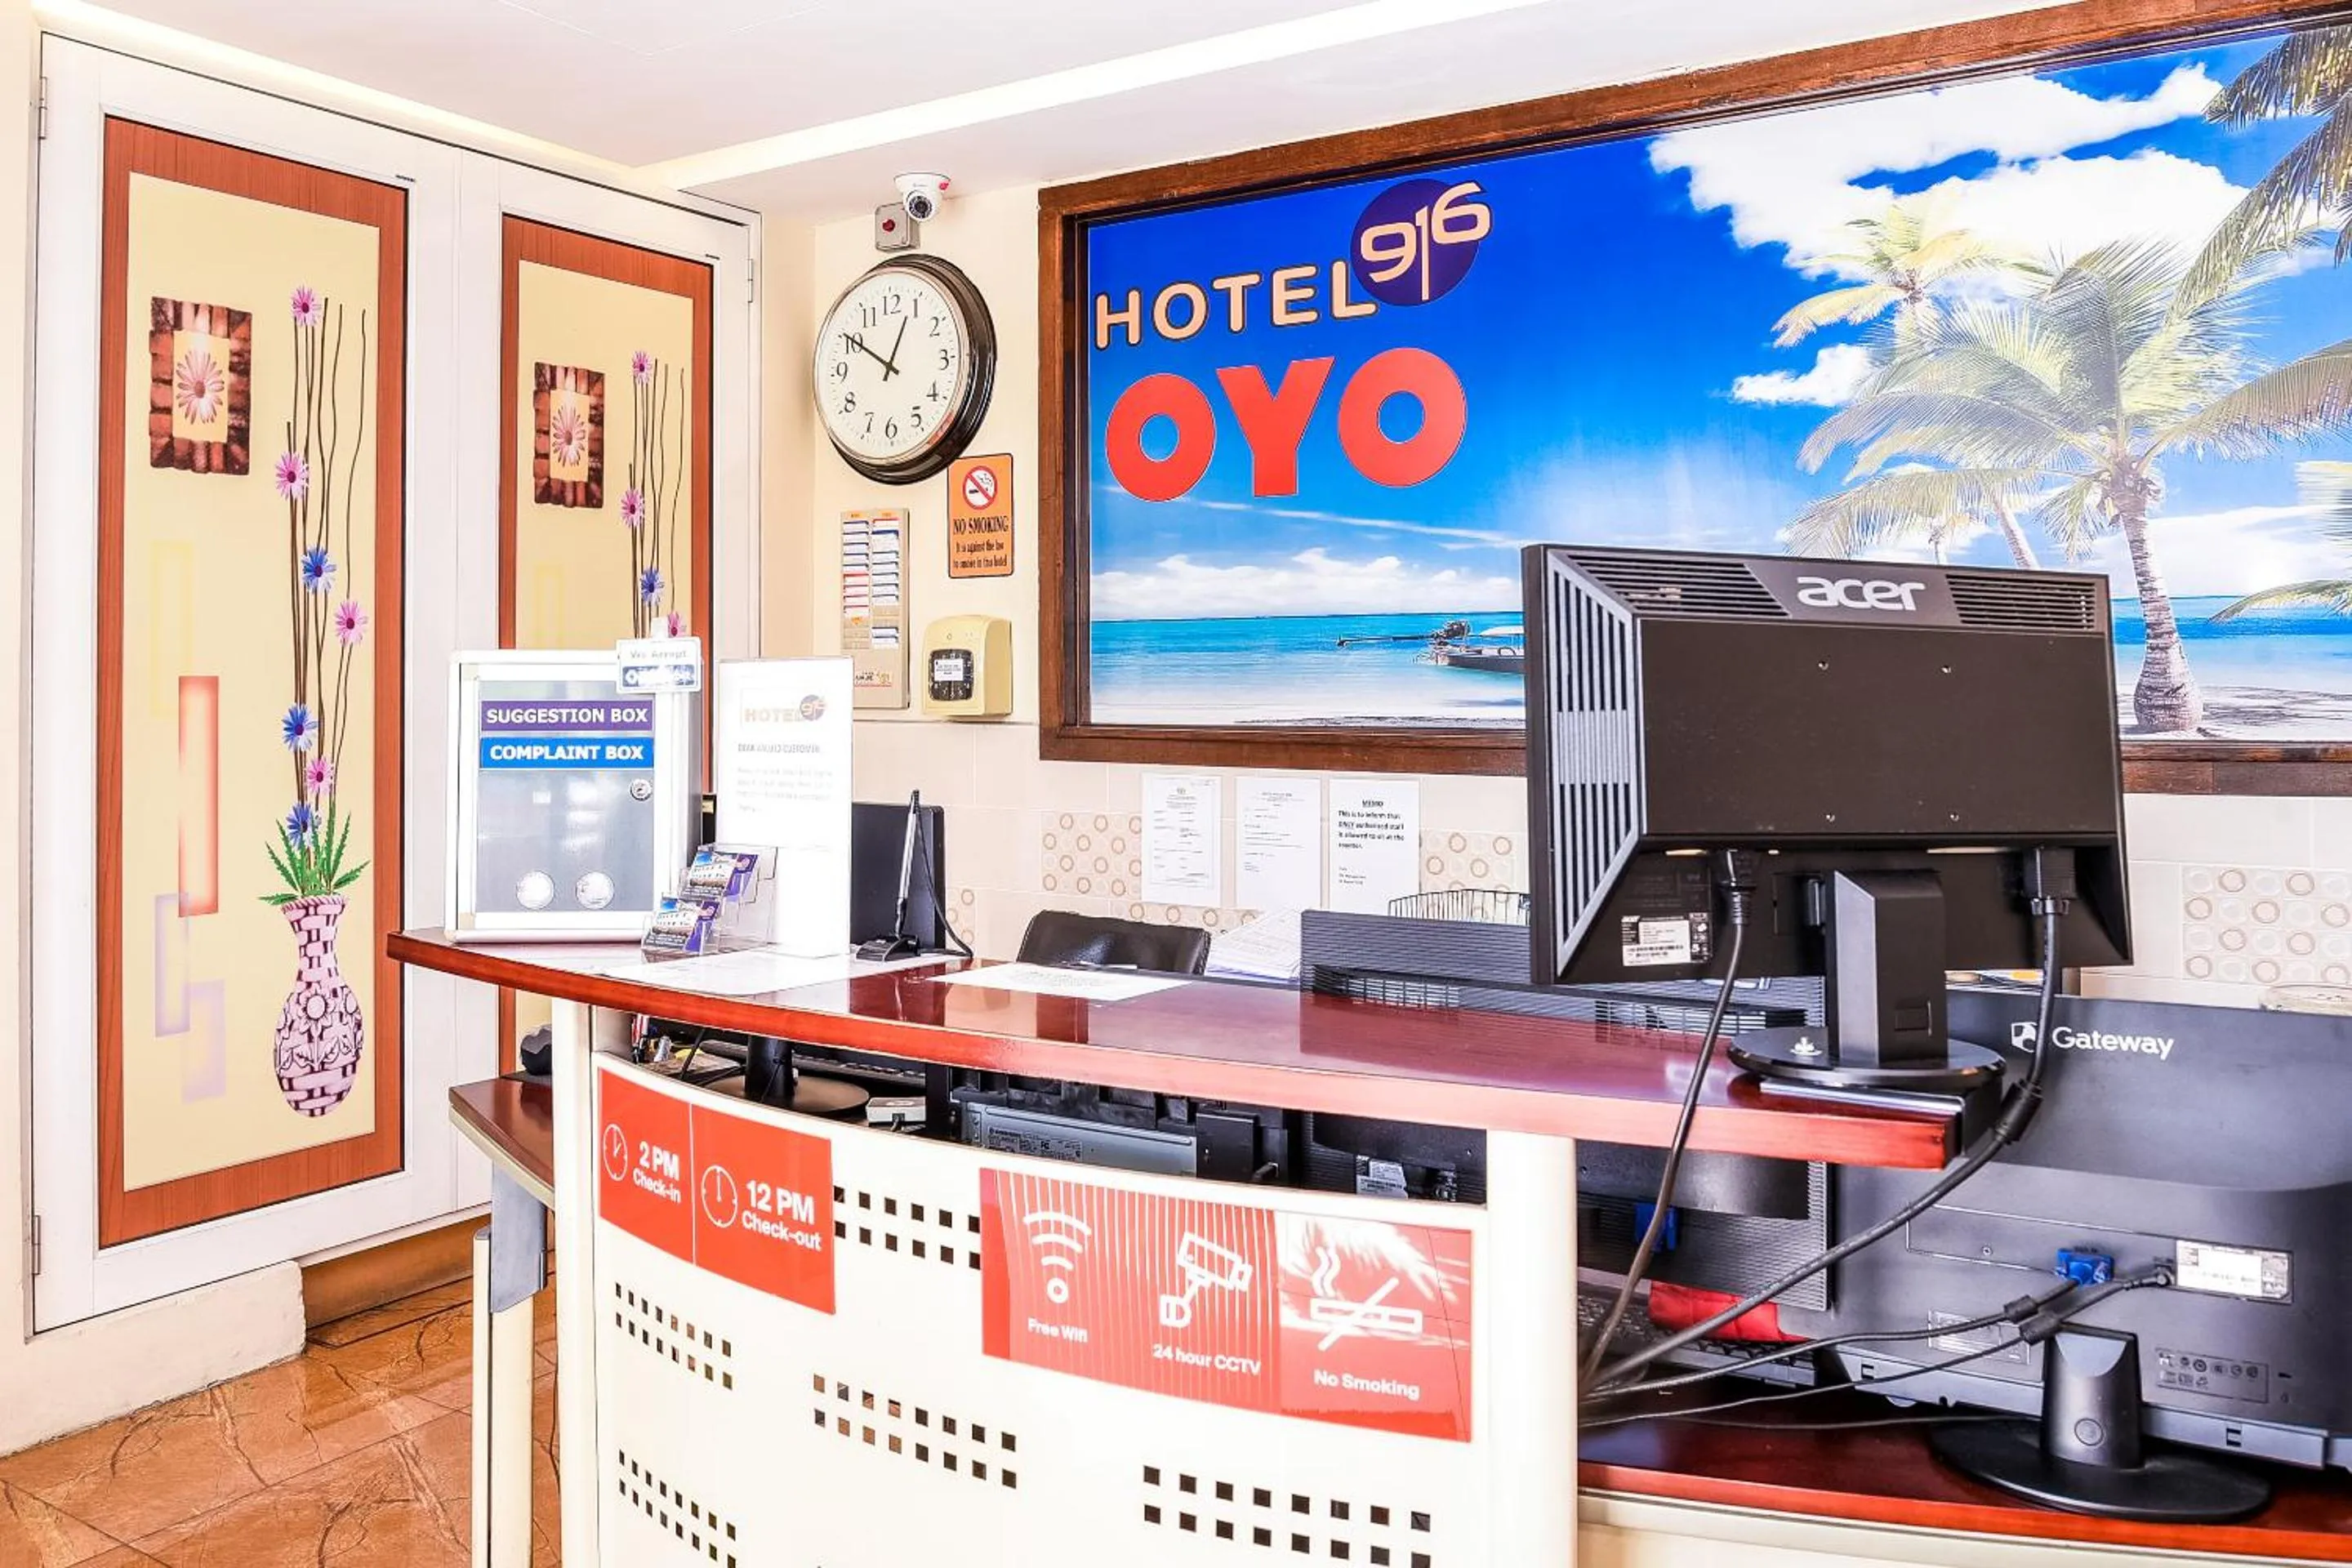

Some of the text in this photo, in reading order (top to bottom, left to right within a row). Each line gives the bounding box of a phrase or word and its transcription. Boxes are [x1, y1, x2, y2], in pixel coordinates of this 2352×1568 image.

[1095, 180, 1491, 350] HOTEL 916
[882, 294, 902, 316] 12
[911, 297, 918, 318] 1
[861, 305, 876, 328] 11
[929, 316, 940, 337] 2
[844, 332, 863, 354] 10
[940, 349, 950, 371] 3
[836, 361, 848, 383] 9
[844, 391, 856, 413] 8
[926, 380, 939, 402] 4
[865, 412, 874, 434] 7
[885, 416, 898, 439] 6
[911, 405, 921, 428] 5
[1106, 347, 1468, 502] OYO
[953, 516, 1009, 535] NO SMOKING
[1797, 577, 1926, 611] acer
[487, 708, 648, 724] SUGGESTION BOX
[744, 708, 804, 723] HOTEL
[490, 745, 644, 760] COMPLAINT BOX
[2051, 1027, 2175, 1060] Gateway
[639, 1141, 679, 1181] 2 PM
[633, 1167, 681, 1205] Check-in
[746, 1179, 815, 1225] 12 PM
[742, 1210, 822, 1251] Check-out
[1027, 1317, 1059, 1338] Free
[1152, 1343, 1261, 1376] 24 hour CCTV
[1313, 1369, 1421, 1401] No Smoking
